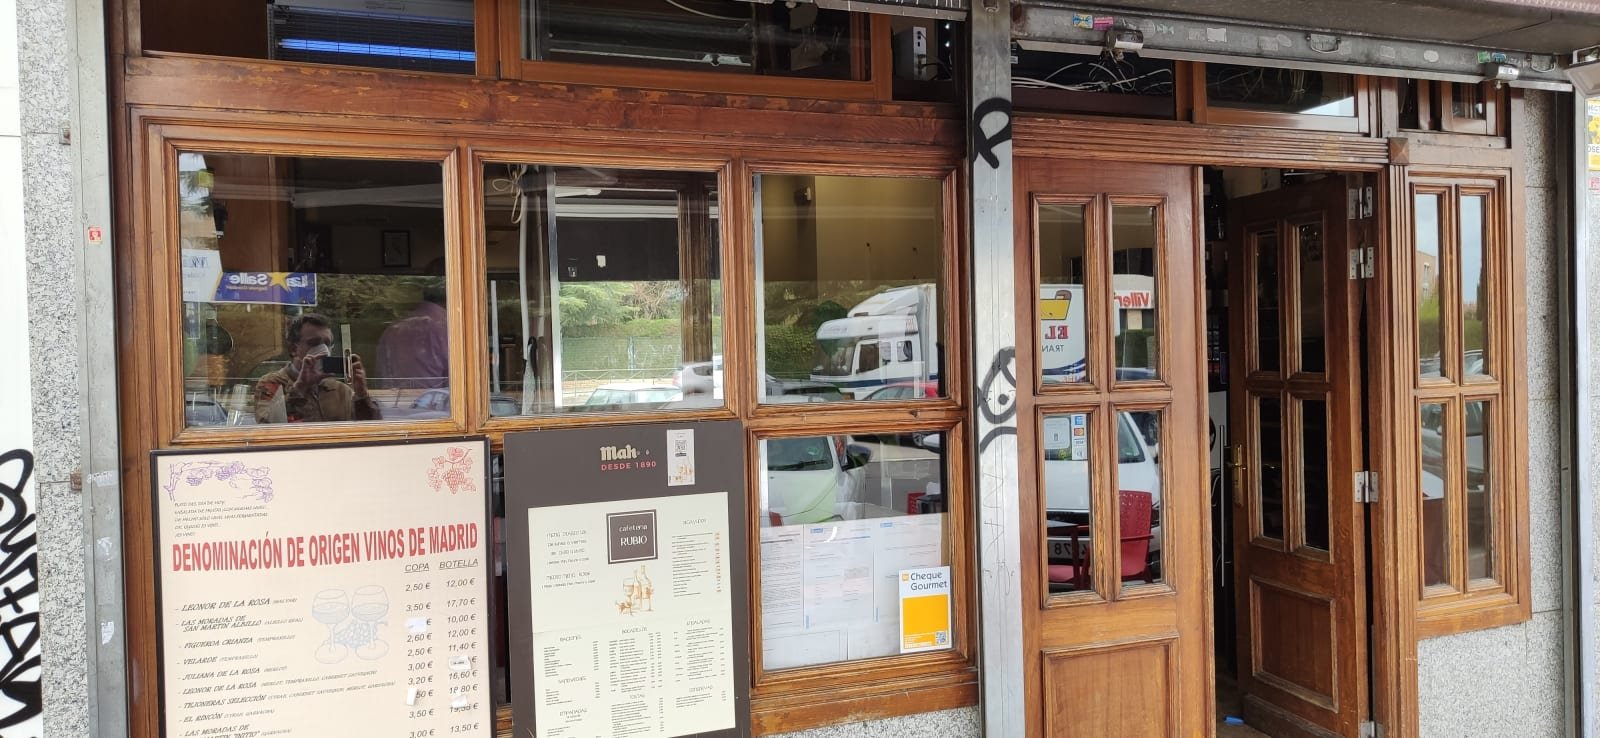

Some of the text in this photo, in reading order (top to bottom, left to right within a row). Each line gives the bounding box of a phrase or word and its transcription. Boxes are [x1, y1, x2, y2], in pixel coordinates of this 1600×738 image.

[601, 460, 656, 471] DESDE 1890
[620, 535, 648, 547] RUBIO
[173, 522, 477, 571] DENOMINACIÓN DE ORIGEN VINOS DE MADRID
[404, 562, 430, 573] COPA
[440, 558, 479, 570] BOTELLA
[910, 572, 943, 582] Cheque
[405, 583, 424, 592] 2,50
[447, 578, 468, 588] 12,00
[910, 581, 947, 591] Gourmet
[181, 602, 217, 612] LEONOR
[219, 600, 232, 609] DE
[233, 599, 245, 608] LA
[247, 597, 271, 607] ROSA
[405, 603, 424, 613] 3,50
[447, 598, 469, 608] 17,70
[180, 618, 197, 627] LAS
[198, 616, 233, 625] MORADAS
[447, 614, 469, 624] 10,00
[183, 625, 199, 633] SAN
[448, 628, 469, 639] 12,00
[221, 637, 253, 646] CRIANZA
[406, 633, 425, 644] 2,60
[407, 647, 425, 657] 2,50
[448, 642, 470, 652] 11,40
[183, 656, 218, 665] VELARDE
[407, 661, 426, 671] 3,00
[182, 671, 215, 681] JULIANA
[217, 670, 228, 678] DE
[229, 669, 239, 677] LA
[241, 667, 260, 675] ROSA
[407, 676, 426, 686] 3,20
[182, 686, 212, 695] LEONOR
[213, 685, 224, 693] DE
[225, 683, 236, 691] LA
[238, 681, 257, 690] ROSA
[227, 694, 268, 705] SELECCIÓN
[183, 715, 194, 723] EL
[195, 712, 224, 722] RINCÓN
[184, 729, 200, 737] LAS
[201, 725, 237, 735] MORADAS
[238, 723, 250, 731] DE
